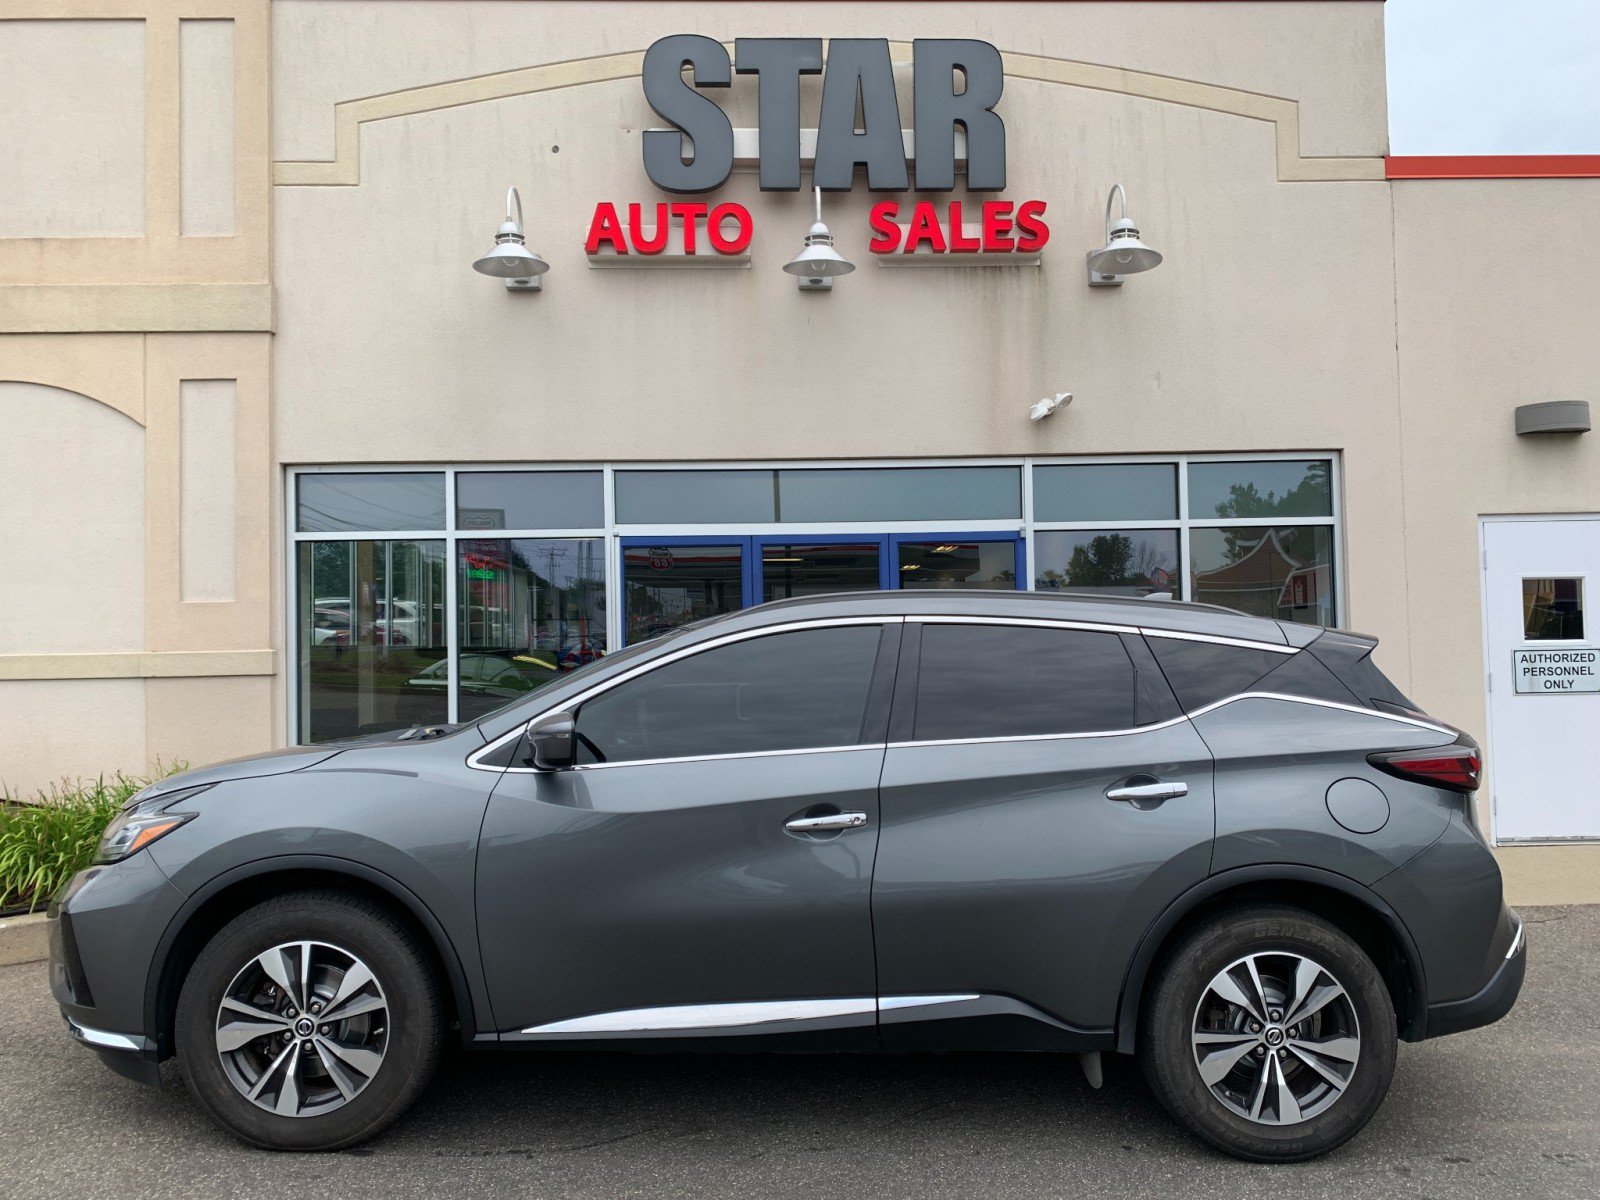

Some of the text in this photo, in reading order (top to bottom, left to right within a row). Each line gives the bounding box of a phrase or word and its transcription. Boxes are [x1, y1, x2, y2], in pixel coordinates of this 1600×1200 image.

[643, 34, 1006, 192] STAR
[585, 200, 1050, 256] AUTO SALES
[1520, 653, 1596, 663] AUTHORIZED
[1523, 666, 1595, 676] PERSONNEL
[1543, 679, 1575, 689] ONLY
